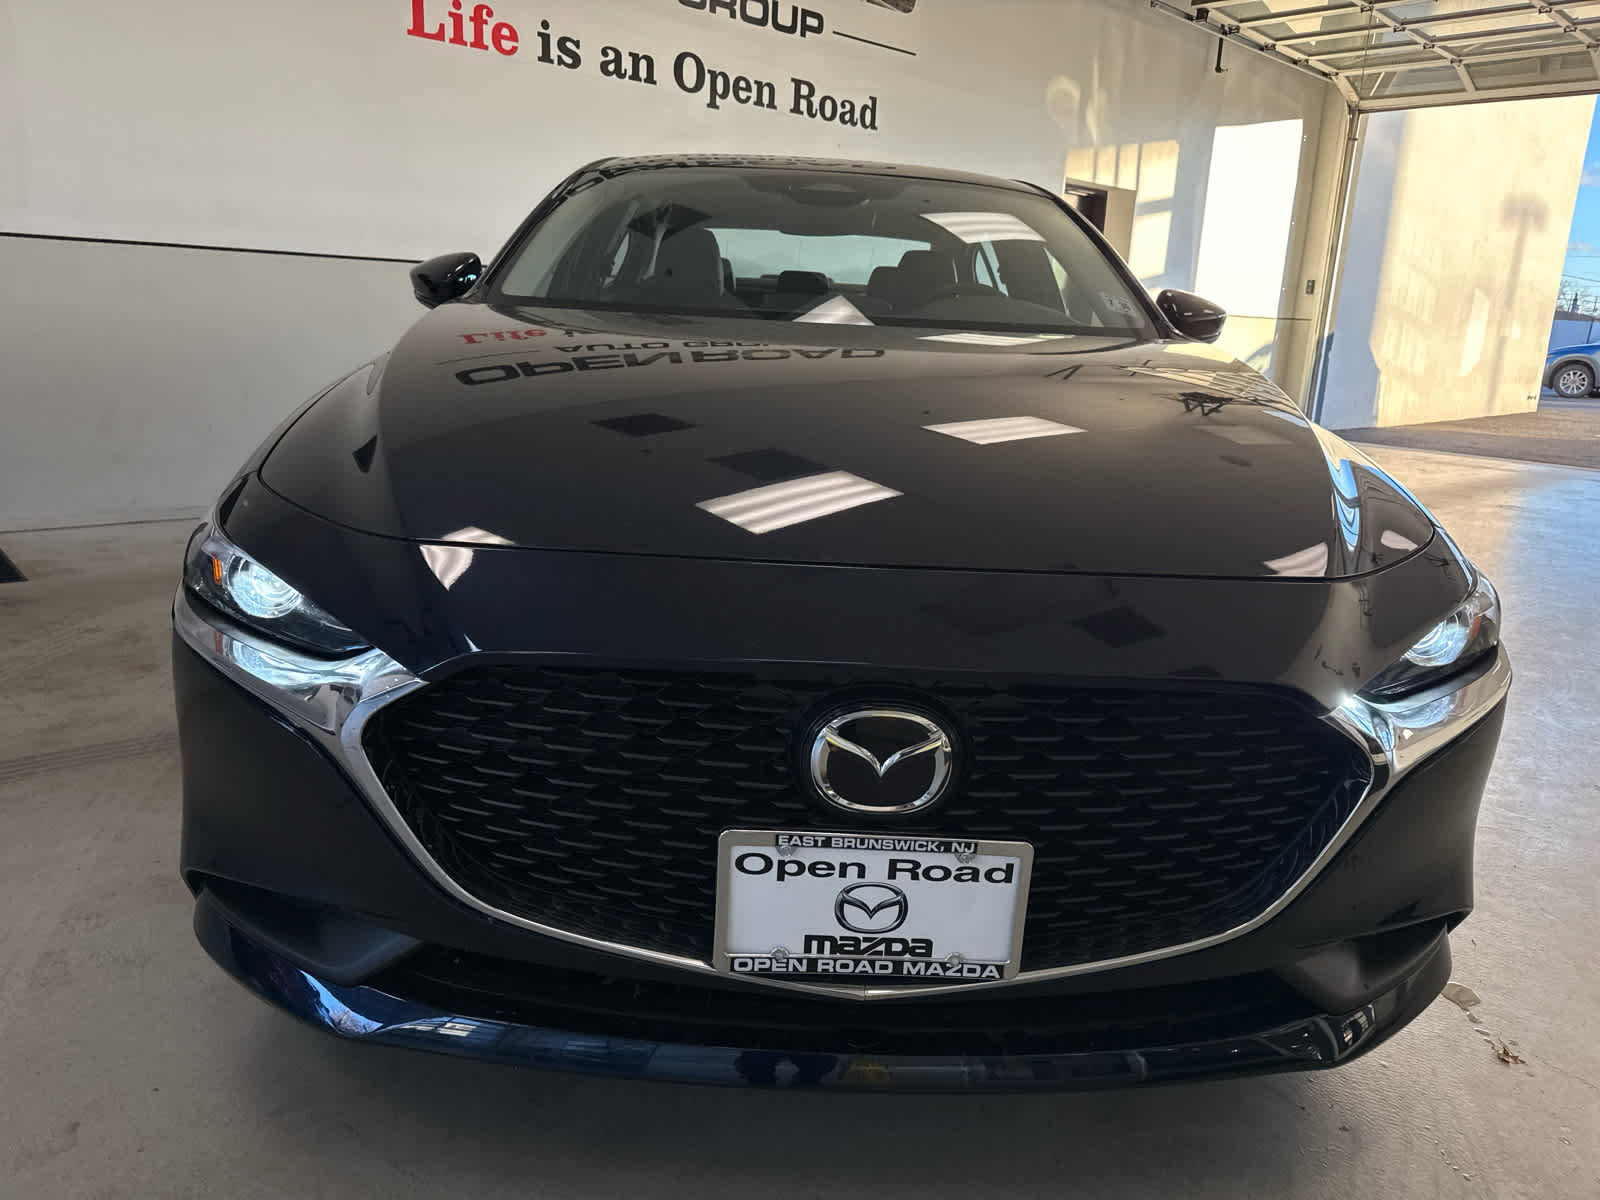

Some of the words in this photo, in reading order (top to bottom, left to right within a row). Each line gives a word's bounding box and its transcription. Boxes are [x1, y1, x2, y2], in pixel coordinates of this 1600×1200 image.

[407, 0, 519, 56] Life
[537, 19, 582, 70] is
[600, 45, 657, 85] an
[673, 51, 778, 110] Open
[790, 77, 878, 130] Road
[778, 835, 826, 847] EAST
[831, 837, 944, 852] BRUNSWICK,
[951, 842, 976, 853] NJ
[734, 852, 866, 881] Open
[887, 858, 1015, 883] Road
[733, 958, 808, 972] OPEN
[817, 959, 894, 974] ROAD
[902, 961, 1001, 978] MAZDA
